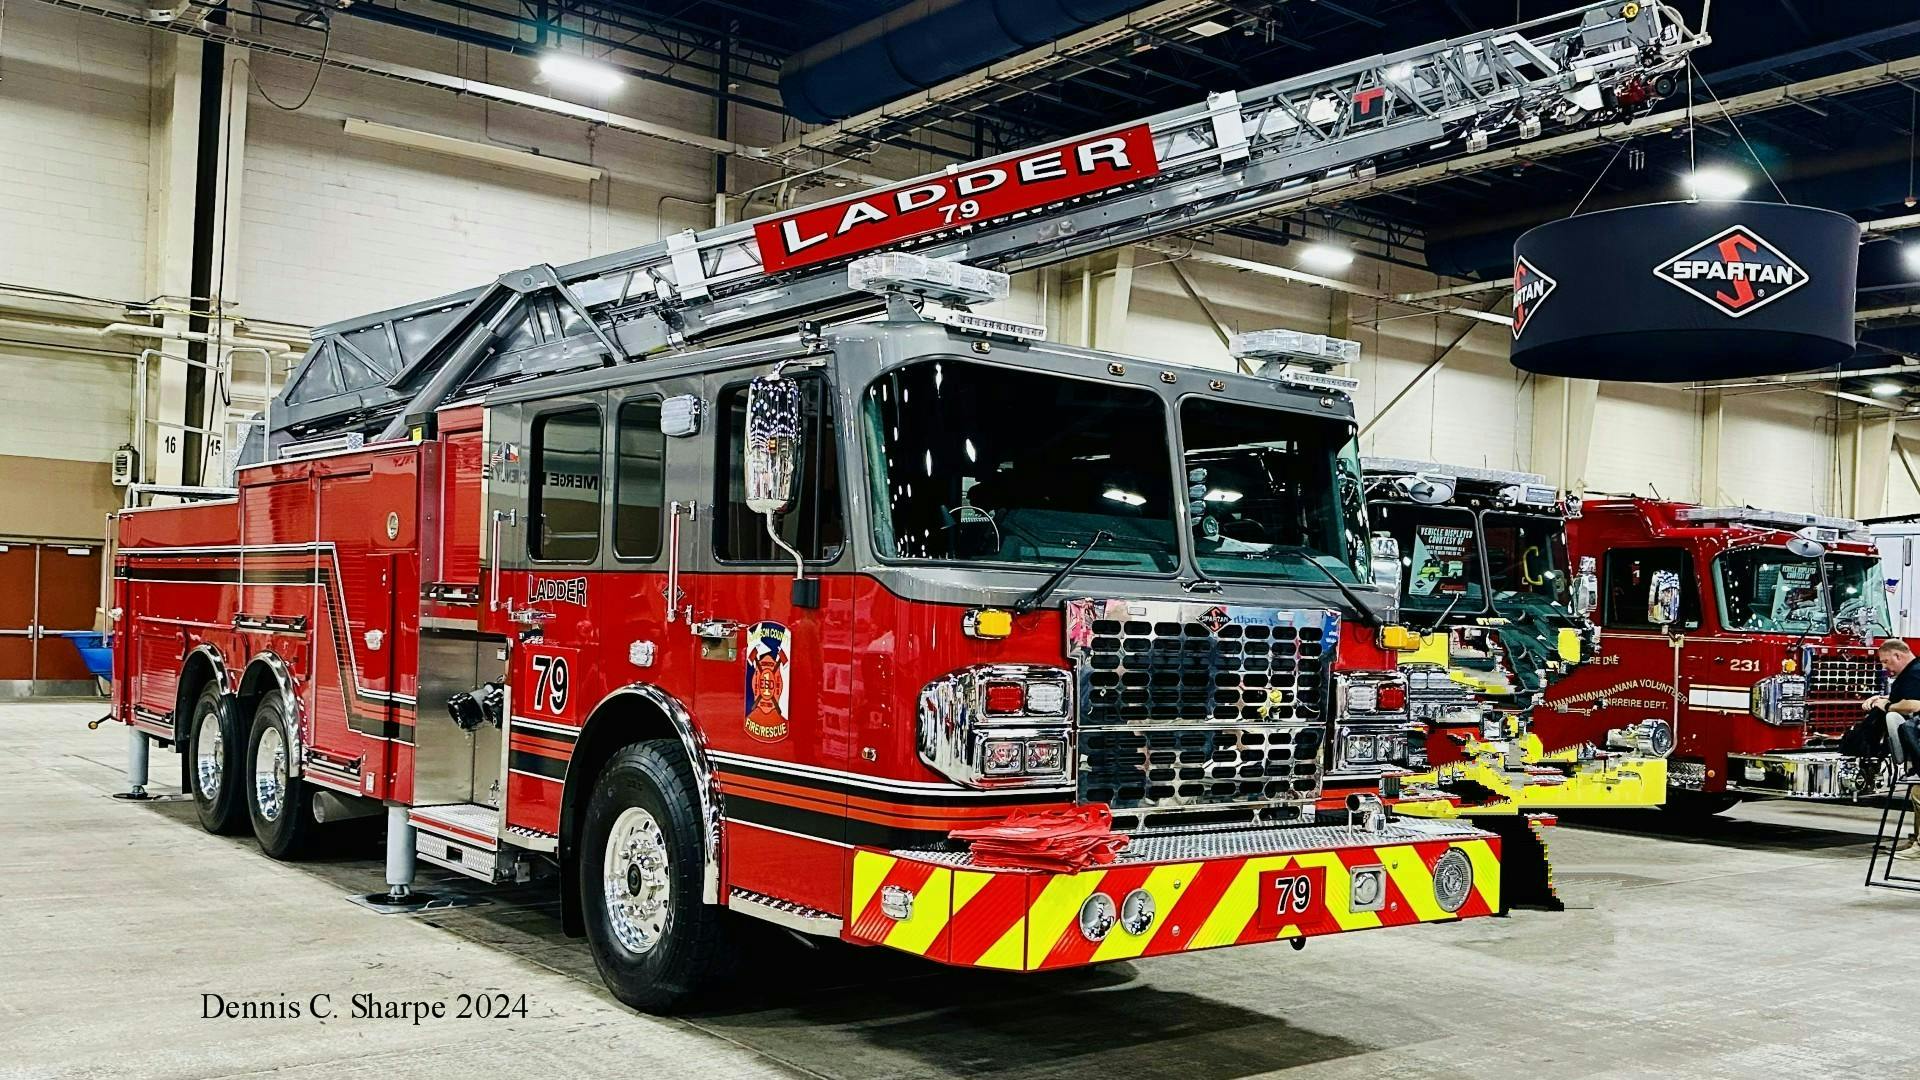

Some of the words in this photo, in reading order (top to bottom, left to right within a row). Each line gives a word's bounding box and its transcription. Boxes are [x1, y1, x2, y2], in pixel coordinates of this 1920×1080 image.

[780, 137, 1132, 256] LADDER
[938, 200, 980, 224] 79
[1672, 259, 1794, 285] SPARTAN
[165, 436, 177, 454] 16
[210, 440, 221, 457] 15
[528, 574, 587, 608] LADDER
[1729, 659, 1761, 672] 231
[532, 654, 569, 715] 79
[1643, 700, 1669, 710] DEPT.
[745, 719, 786, 738] FIRE/RESCUE
[1275, 875, 1312, 914] 79
